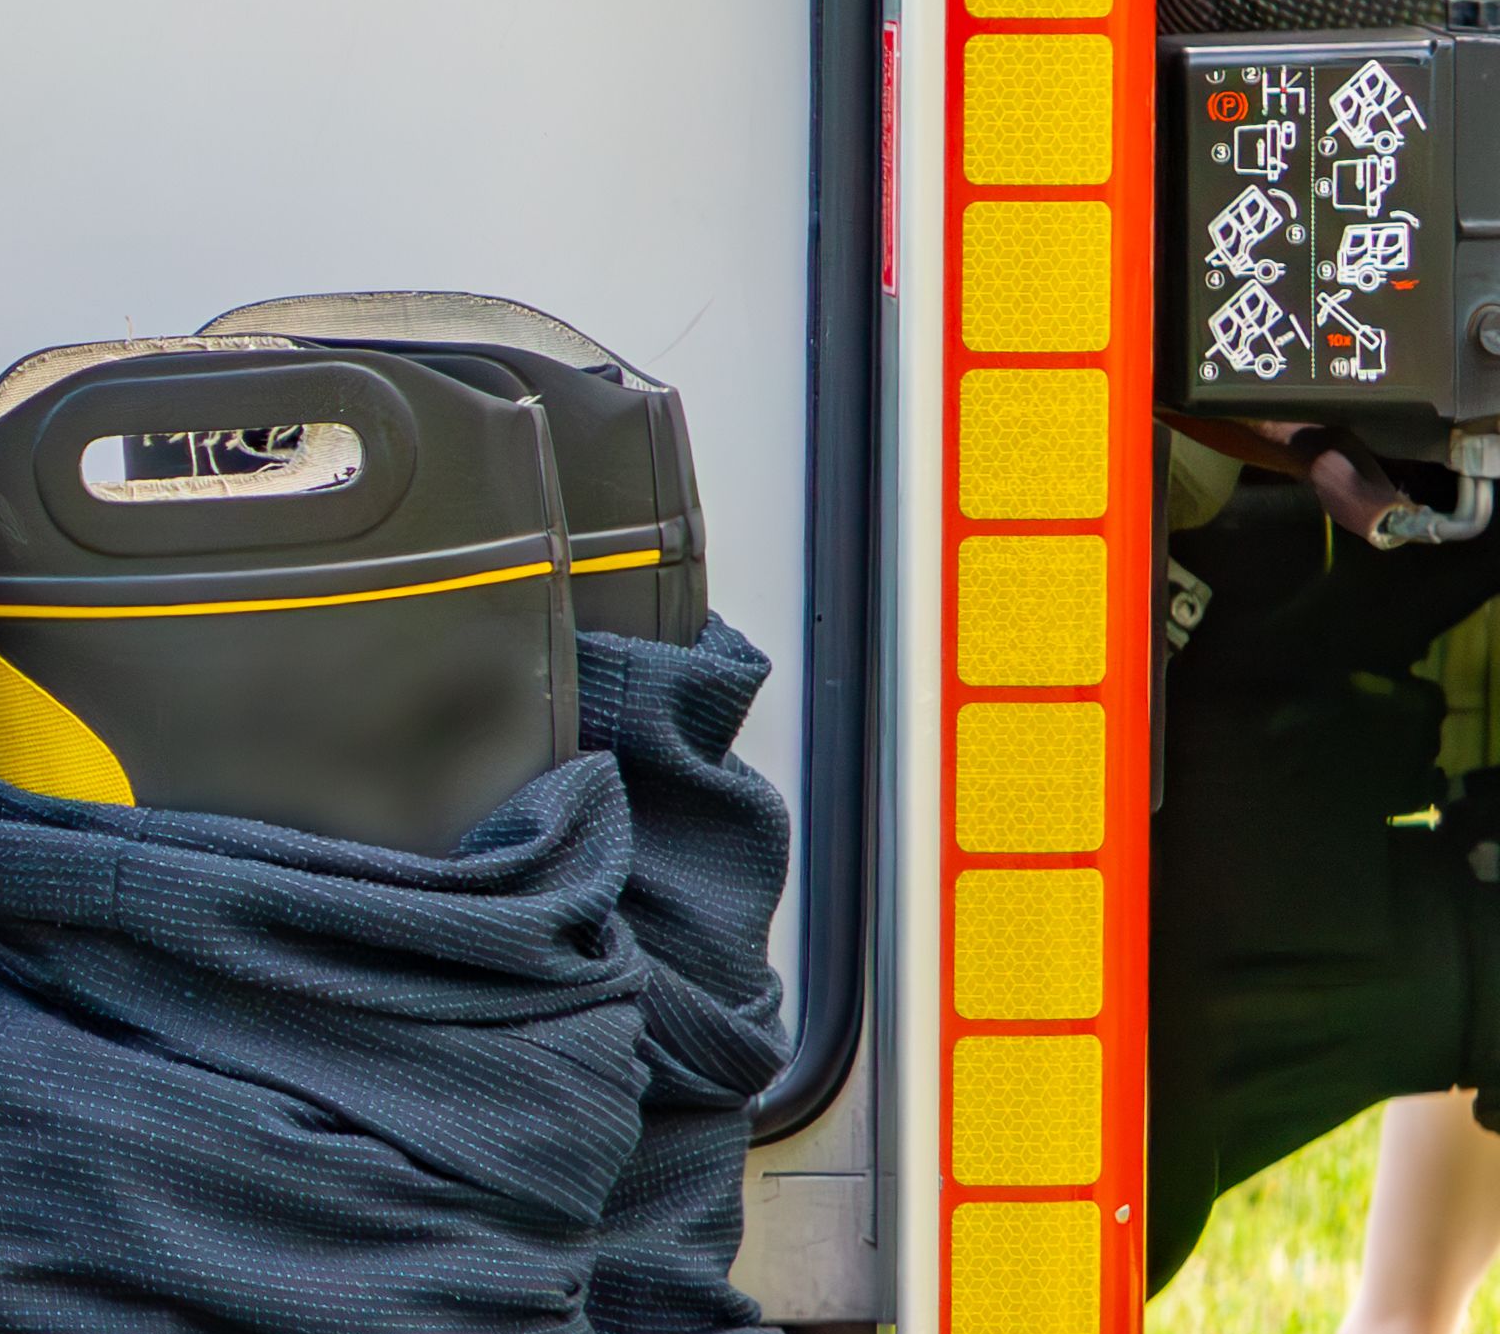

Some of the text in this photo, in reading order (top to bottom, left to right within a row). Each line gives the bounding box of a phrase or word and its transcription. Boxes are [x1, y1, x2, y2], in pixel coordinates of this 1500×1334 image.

[1244, 66, 1258, 81] 2
[1214, 144, 1228, 160] 3
[1321, 138, 1334, 154] 7
[1289, 226, 1302, 242] 5
[1320, 263, 1333, 279] 9
[1208, 272, 1222, 287] 4
[1202, 363, 1216, 379] 6
[1332, 359, 1347, 374] 10
